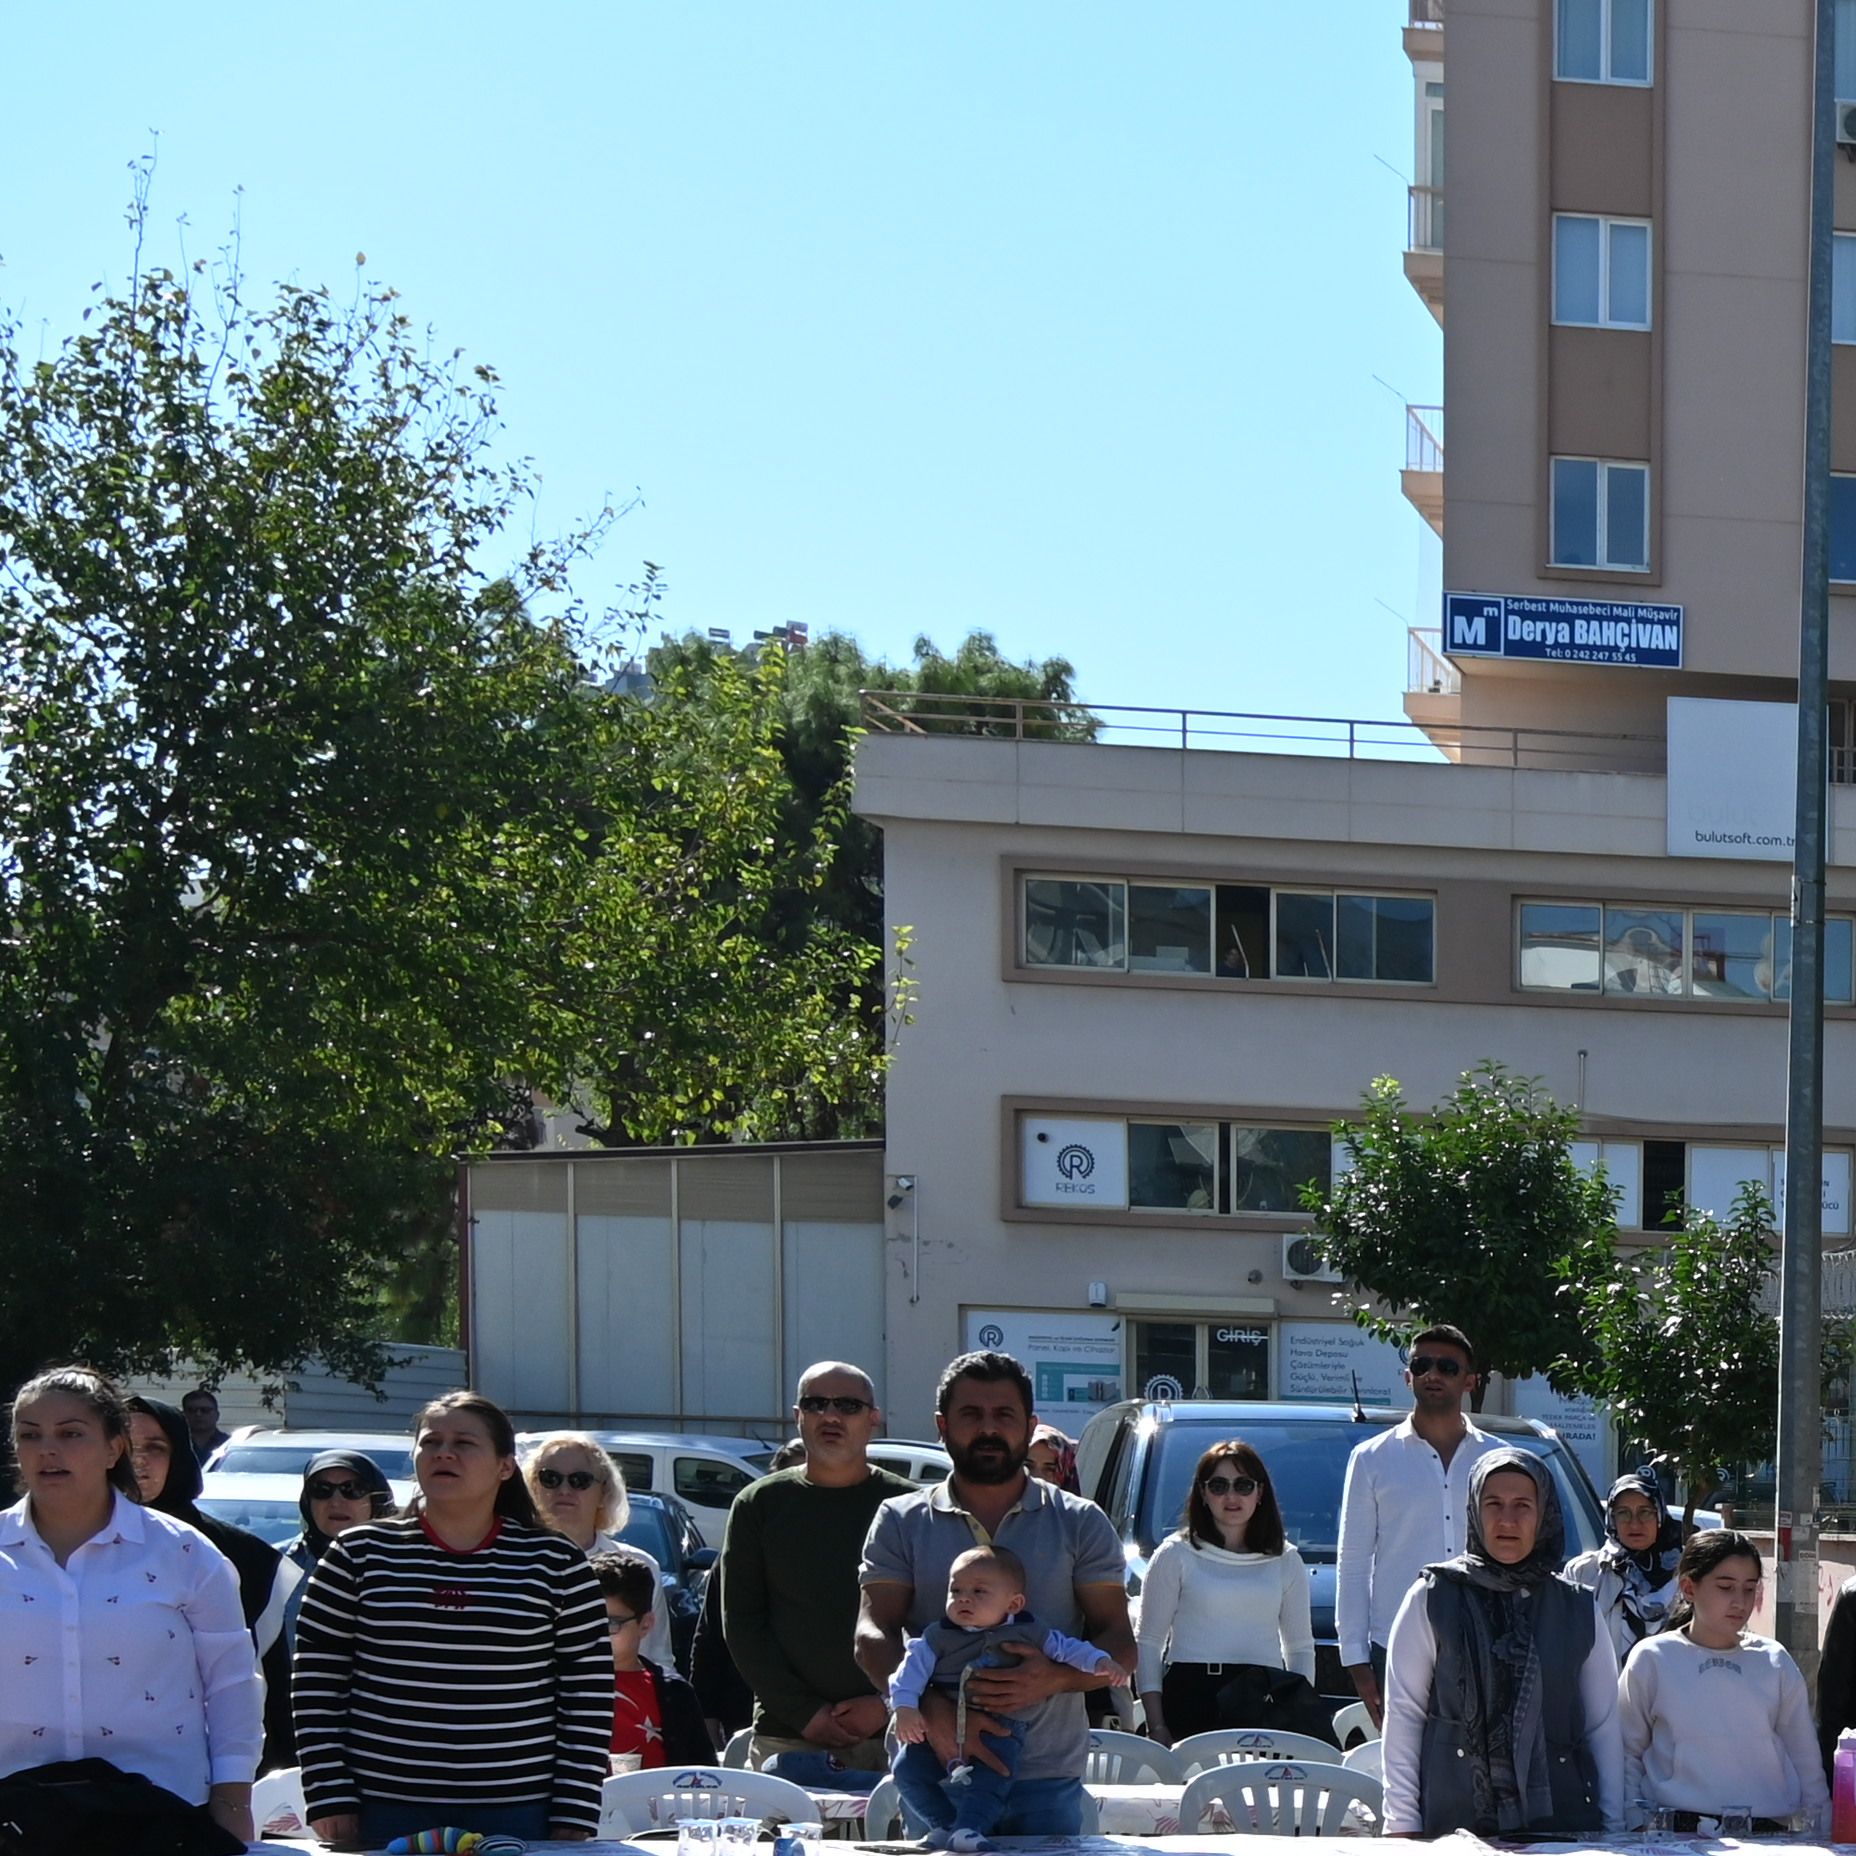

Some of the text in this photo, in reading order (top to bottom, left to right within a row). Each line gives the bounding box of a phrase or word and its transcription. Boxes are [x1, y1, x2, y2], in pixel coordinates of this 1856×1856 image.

[1507, 598, 1678, 622] Serbest Muhasebeci Mali Müşavir
[1507, 615, 1678, 652] Derya BAHÇİVAN
[1545, 648, 1637, 662] Tel: 0 242 247 55 45
[1695, 830, 1795, 847] bulutsoft.com.tr
[1055, 1182, 1096, 1195] REKOS
[1216, 1326, 1262, 1346] GİRİŞ
[1290, 1348, 1348, 1358] Hava Deposu
